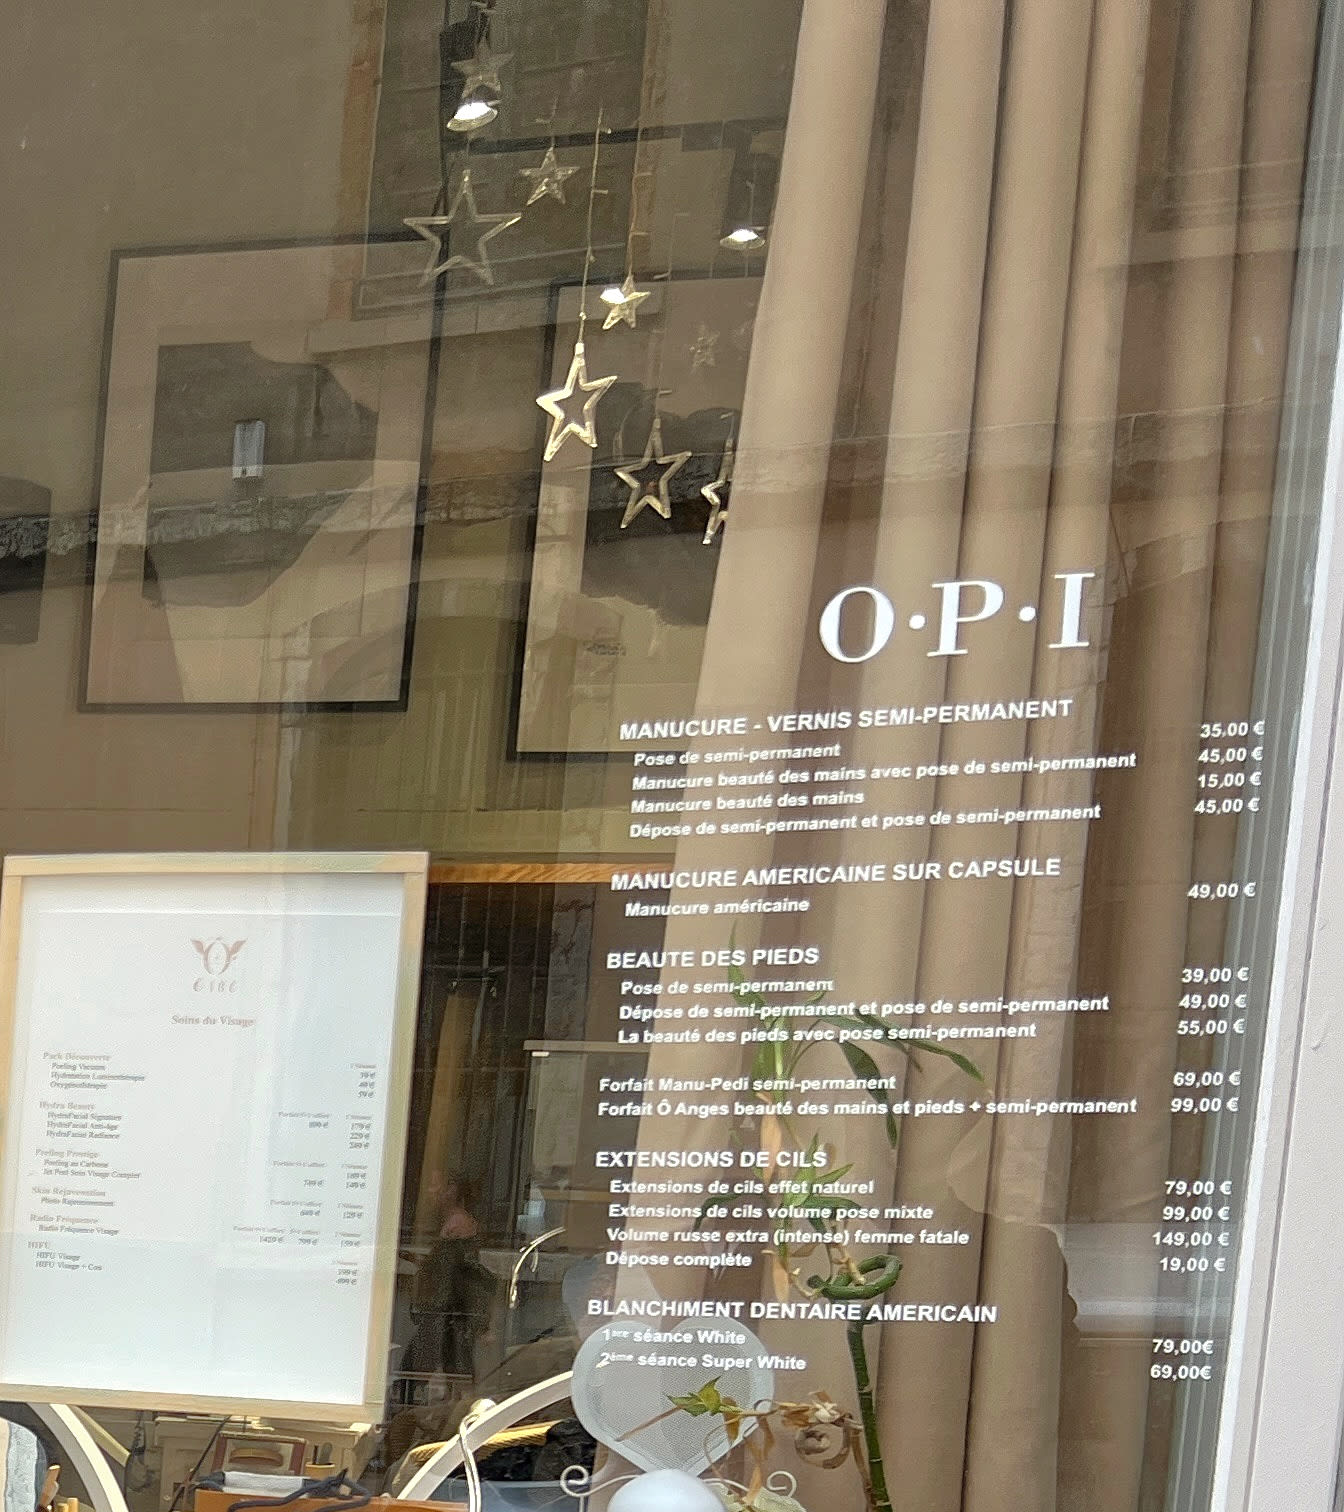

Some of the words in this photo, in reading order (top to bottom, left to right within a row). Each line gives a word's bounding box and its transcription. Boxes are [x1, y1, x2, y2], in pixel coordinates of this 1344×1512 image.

[620, 718, 746, 740] MANUCURE
[767, 711, 852, 732] VERNIS
[858, 699, 1073, 728] SEMI-PERMANENT
[1200, 722, 1248, 738] 35,00
[634, 753, 674, 766] Pose
[679, 750, 699, 764] de
[704, 744, 841, 764] semi-permanent
[1198, 748, 1247, 765] 45,00
[632, 776, 712, 790] Manucure
[718, 770, 774, 786] beauté
[779, 767, 809, 784] des
[814, 766, 866, 782] mains
[870, 765, 911, 779] avec
[916, 764, 959, 779] pose
[964, 758, 985, 775] de
[991, 753, 1136, 773] semi-permanent
[1198, 773, 1245, 789] 15,00
[631, 799, 711, 814] Manucure
[717, 793, 772, 810] beauté
[777, 791, 808, 808] des
[812, 791, 864, 806] mains
[1194, 798, 1243, 814] 45,00
[630, 822, 690, 839] Dépose
[696, 821, 716, 835] de
[721, 815, 857, 835] semi-permanent
[862, 815, 877, 828] et
[883, 814, 925, 830] pose
[930, 810, 952, 826] de
[956, 802, 1101, 824] semi-permanent
[611, 870, 737, 891] MANUCURE
[742, 864, 886, 887] AMERICAINE
[893, 863, 941, 881] SUR
[948, 858, 1061, 877] CAPSULE
[1187, 883, 1238, 900] 49,00
[625, 901, 709, 917] Manucure
[714, 898, 810, 914] américaine
[607, 951, 694, 969] BEAUTE
[702, 949, 746, 967] DES
[753, 947, 820, 965] PIEDS
[1181, 968, 1232, 984] 39,00
[621, 981, 662, 995] Pose
[668, 980, 688, 994] de
[619, 1005, 683, 1022] Dépose
[688, 1004, 708, 1018] de
[713, 1002, 857, 1019] semi-permanent
[859, 1002, 877, 1015] et
[881, 1001, 925, 1017] pose
[931, 1000, 954, 1015] de
[958, 996, 1109, 1015] semi-permanent
[1179, 994, 1229, 1010] 49,00
[618, 1030, 639, 1044] La
[643, 1029, 700, 1043] beauté
[705, 1029, 736, 1042] des
[741, 1027, 788, 1044] pieds
[793, 1029, 834, 1041] avec
[839, 1026, 884, 1043] pose
[888, 1023, 1037, 1041] semi-permanent
[1177, 1020, 1227, 1036] 55,00
[599, 1078, 654, 1092] Forfait
[659, 1077, 749, 1091] Manu-Pedi
[753, 1076, 896, 1092] semi-permanent
[1173, 1071, 1224, 1088] 69,00
[598, 1101, 652, 1116] Forfait
[675, 1103, 729, 1118] Anges
[734, 1101, 792, 1115] beauté
[797, 1101, 829, 1115] des
[833, 1100, 888, 1115] mains
[892, 1100, 910, 1114] et
[915, 1100, 964, 1116] pieds
[986, 1098, 1137, 1115] semi-permanent
[1170, 1098, 1221, 1114] 99,00
[595, 1151, 734, 1168] EXTENSIONS
[740, 1151, 769, 1167] DE
[776, 1151, 827, 1167] CILS
[610, 1180, 703, 1194] Extensions
[708, 1181, 729, 1194] de
[734, 1180, 763, 1194] cils
[768, 1181, 808, 1194] effet
[813, 1180, 874, 1194] naturel
[1164, 1180, 1214, 1197] 79,00
[609, 1204, 702, 1218] Extensions
[707, 1205, 727, 1218] de
[732, 1205, 762, 1218] cils
[767, 1205, 831, 1219] volume
[836, 1208, 880, 1222] pose
[884, 1205, 934, 1219] mixte
[1163, 1206, 1213, 1222] 99,00
[607, 1228, 669, 1241] Volume
[674, 1231, 720, 1242] russe
[726, 1231, 769, 1243] extra
[774, 1229, 849, 1245] (intense)
[855, 1230, 915, 1244] femme
[919, 1230, 969, 1245] fatale
[1152, 1232, 1212, 1247] 149,00
[606, 1252, 669, 1267] Dépose
[674, 1253, 752, 1267] complète
[1160, 1257, 1209, 1273] 19,00
[588, 1300, 744, 1318] BLANCHIMENT
[751, 1302, 861, 1320] DENTAIRE
[867, 1304, 997, 1322] AMERICAIN
[633, 1328, 692, 1343] séance
[698, 1330, 746, 1345] White
[638, 1352, 697, 1367] séance
[702, 1354, 752, 1370] Super
[757, 1355, 806, 1370] White
